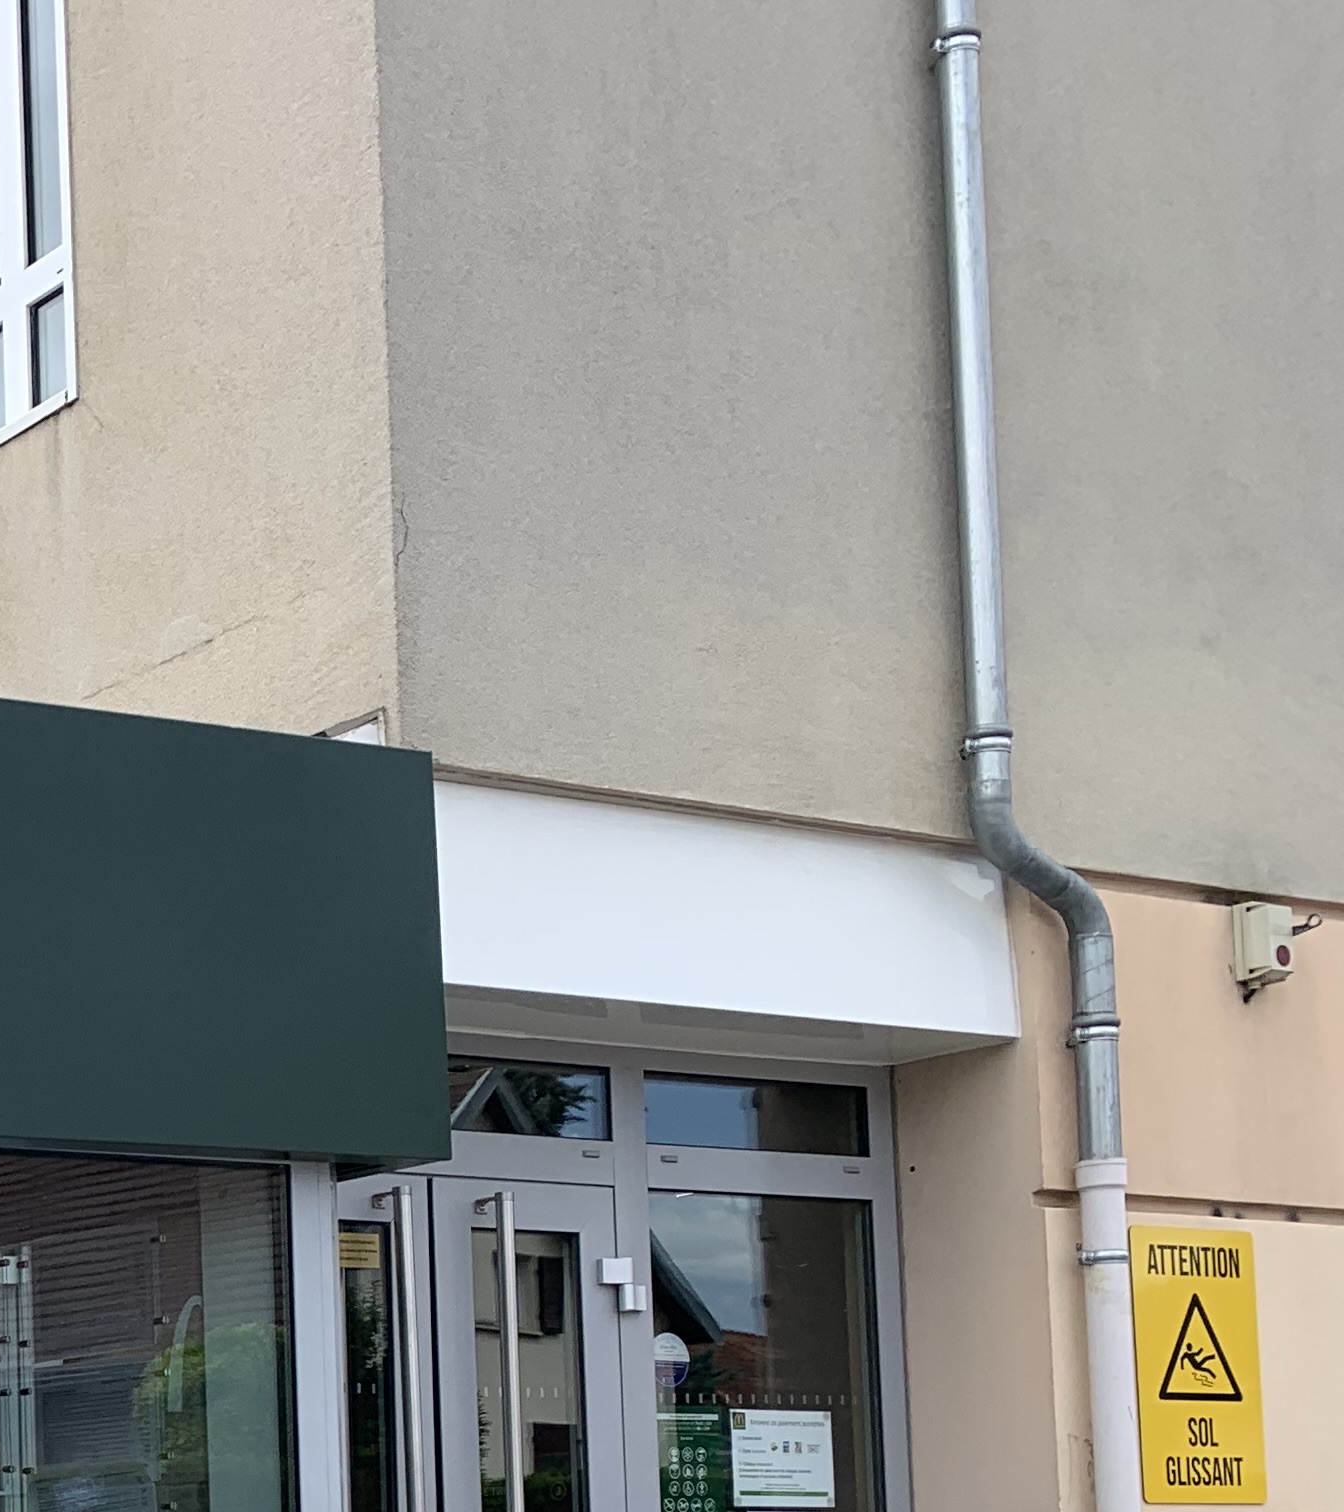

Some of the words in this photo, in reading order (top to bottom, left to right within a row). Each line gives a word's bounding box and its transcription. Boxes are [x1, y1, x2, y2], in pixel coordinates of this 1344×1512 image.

[1147, 1244, 1241, 1278] ATTENTION
[1188, 1417, 1219, 1447] SOL
[1166, 1456, 1244, 1486] GLISSANT
